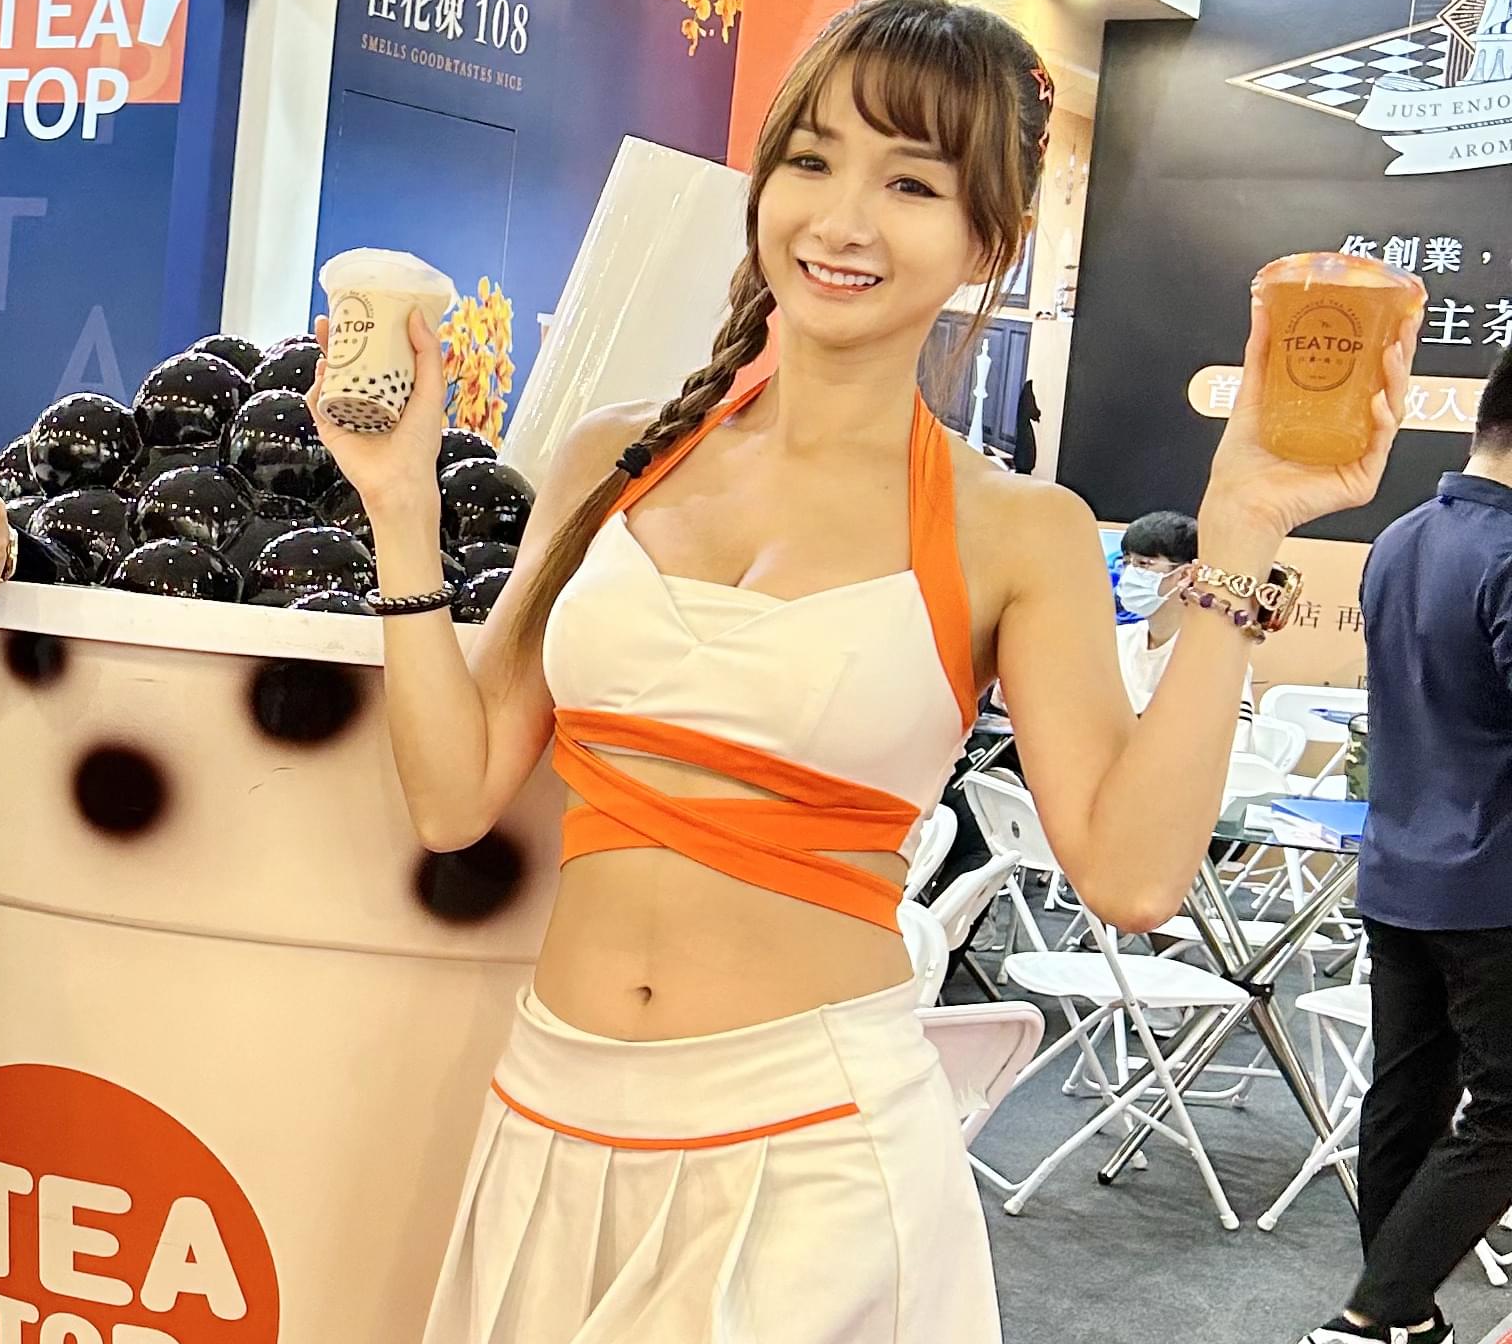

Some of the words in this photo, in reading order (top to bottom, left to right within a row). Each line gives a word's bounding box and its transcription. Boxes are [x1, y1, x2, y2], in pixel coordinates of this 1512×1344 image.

[361, 34, 407, 61] SMELLS
[410, 46, 493, 85] GOOD&TASTES
[496, 68, 522, 92] NICE
[1387, 101, 1442, 120] JUST
[1283, 336, 1364, 354] TEATOP
